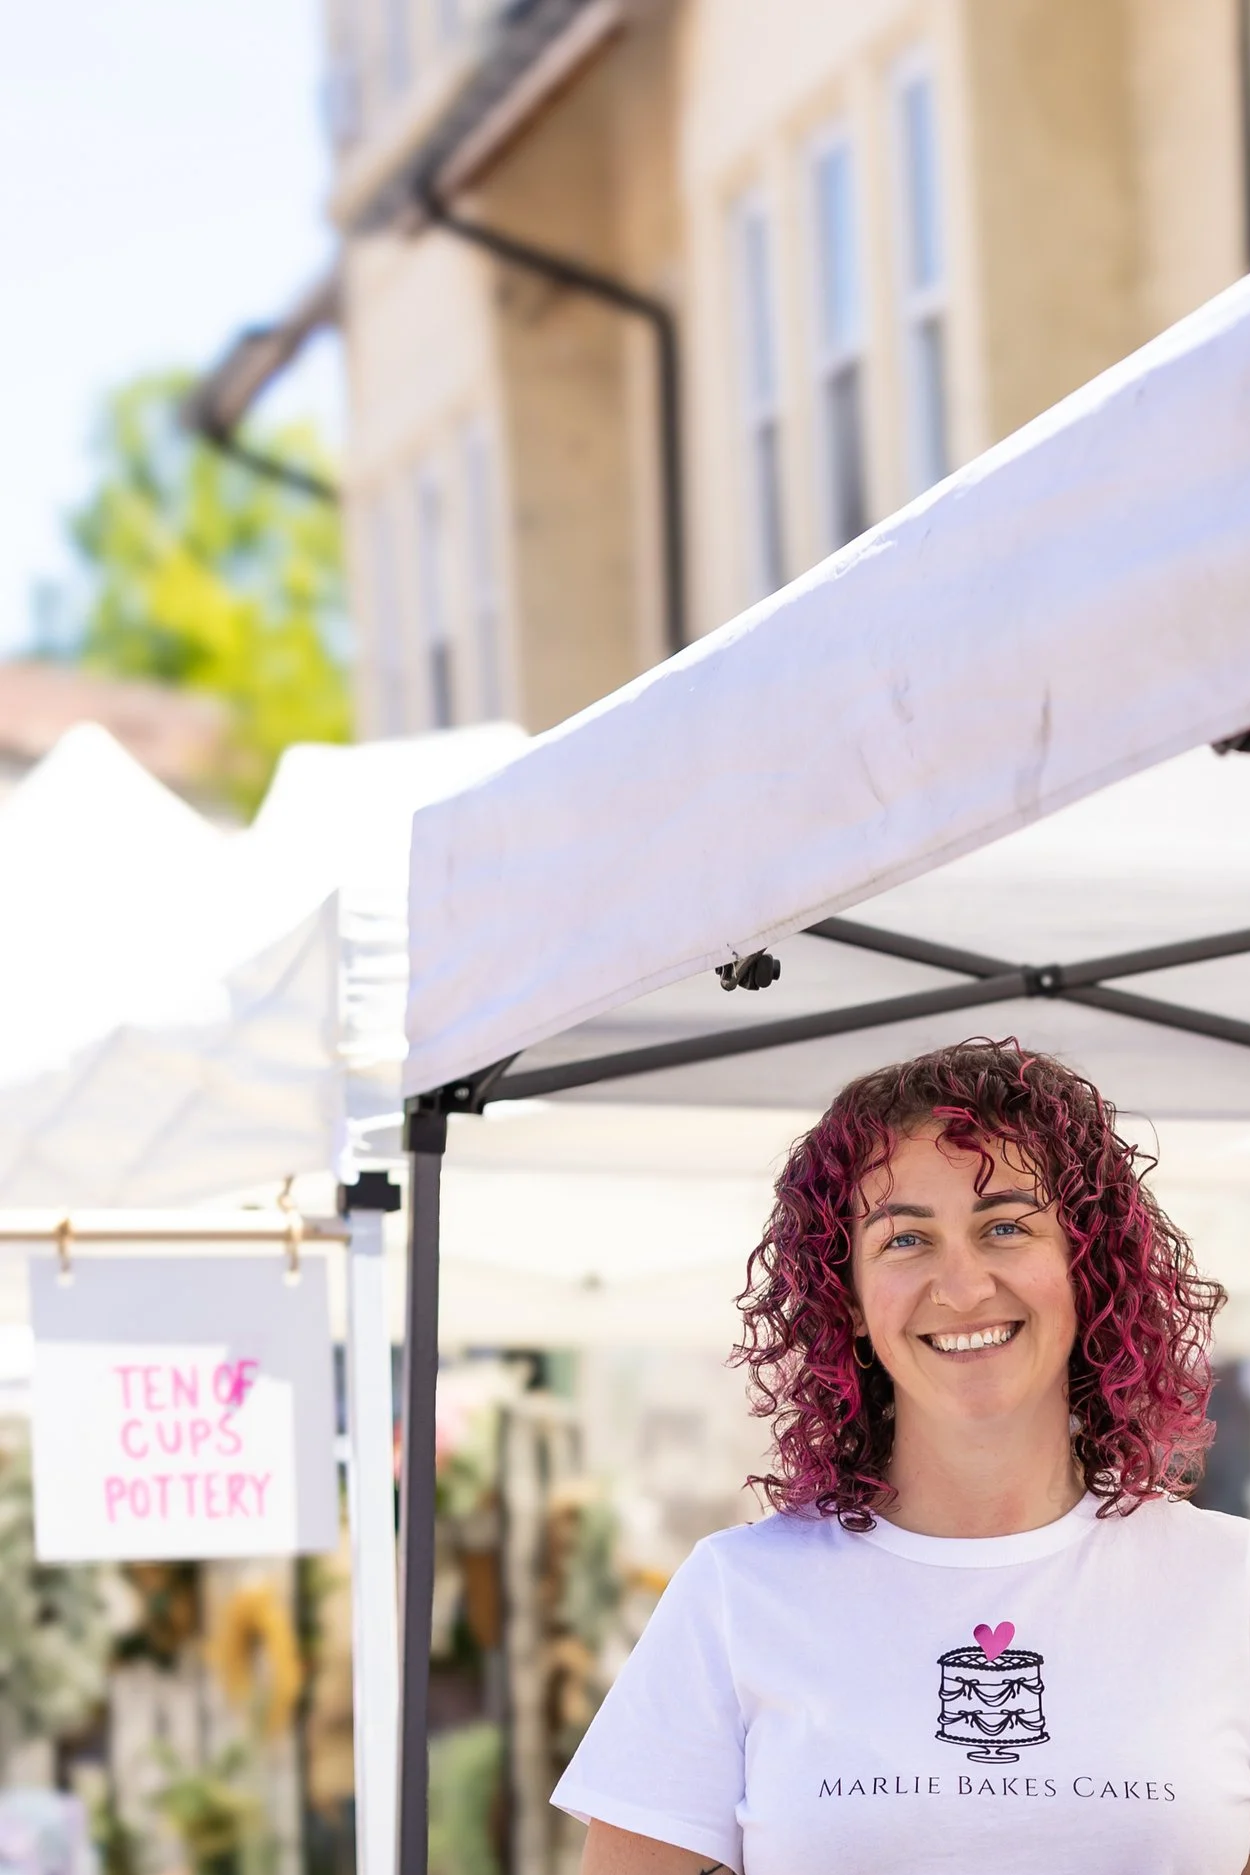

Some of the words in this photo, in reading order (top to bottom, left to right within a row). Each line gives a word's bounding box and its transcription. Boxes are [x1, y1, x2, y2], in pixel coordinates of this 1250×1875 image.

[112, 1363, 200, 1412] TEN
[212, 1359, 260, 1408] OF
[120, 1412, 243, 1460] CUPS
[104, 1472, 272, 1523] POTTERY
[818, 1776, 940, 1798] MARLIE
[958, 1775, 1057, 1797] BAKES
[1073, 1776, 1176, 1802] CAKES
